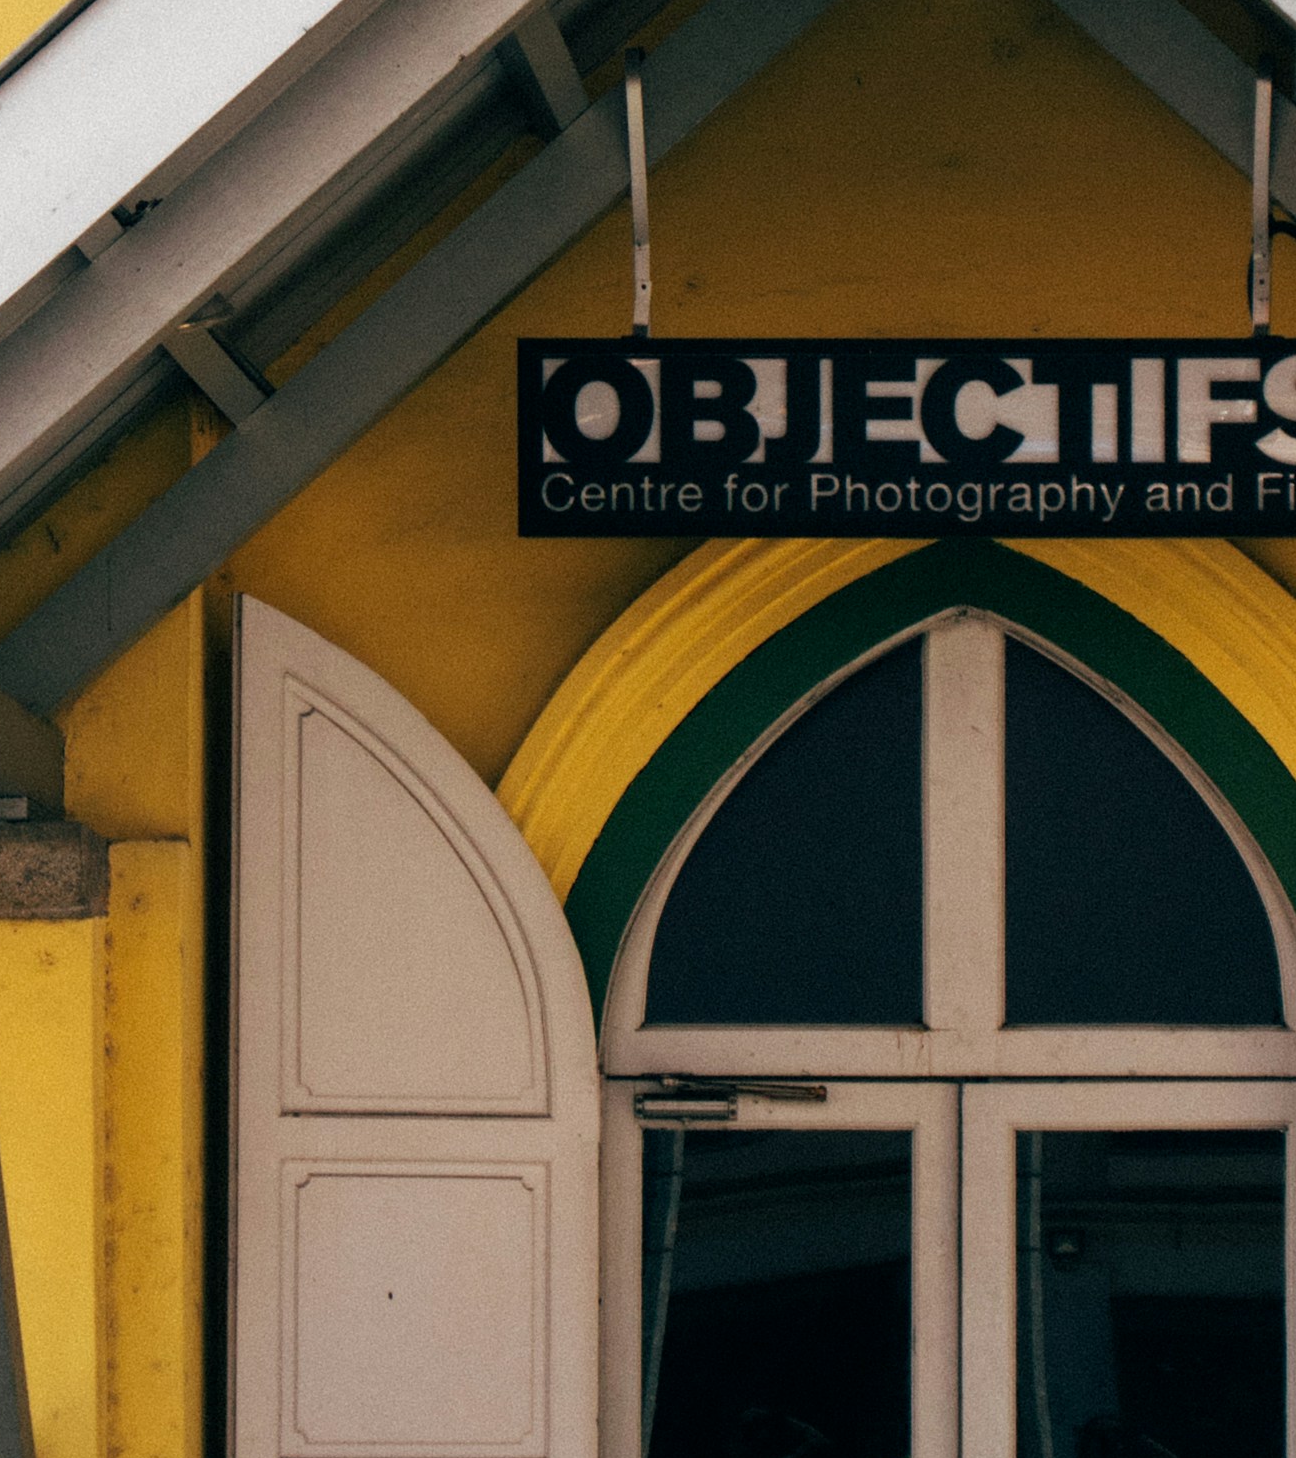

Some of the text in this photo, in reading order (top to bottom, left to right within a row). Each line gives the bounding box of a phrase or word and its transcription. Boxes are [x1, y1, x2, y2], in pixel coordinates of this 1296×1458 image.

[541, 472, 703, 511] Centre
[723, 473, 790, 510] for
[809, 473, 1125, 521] Photography
[1145, 473, 1233, 511] and
